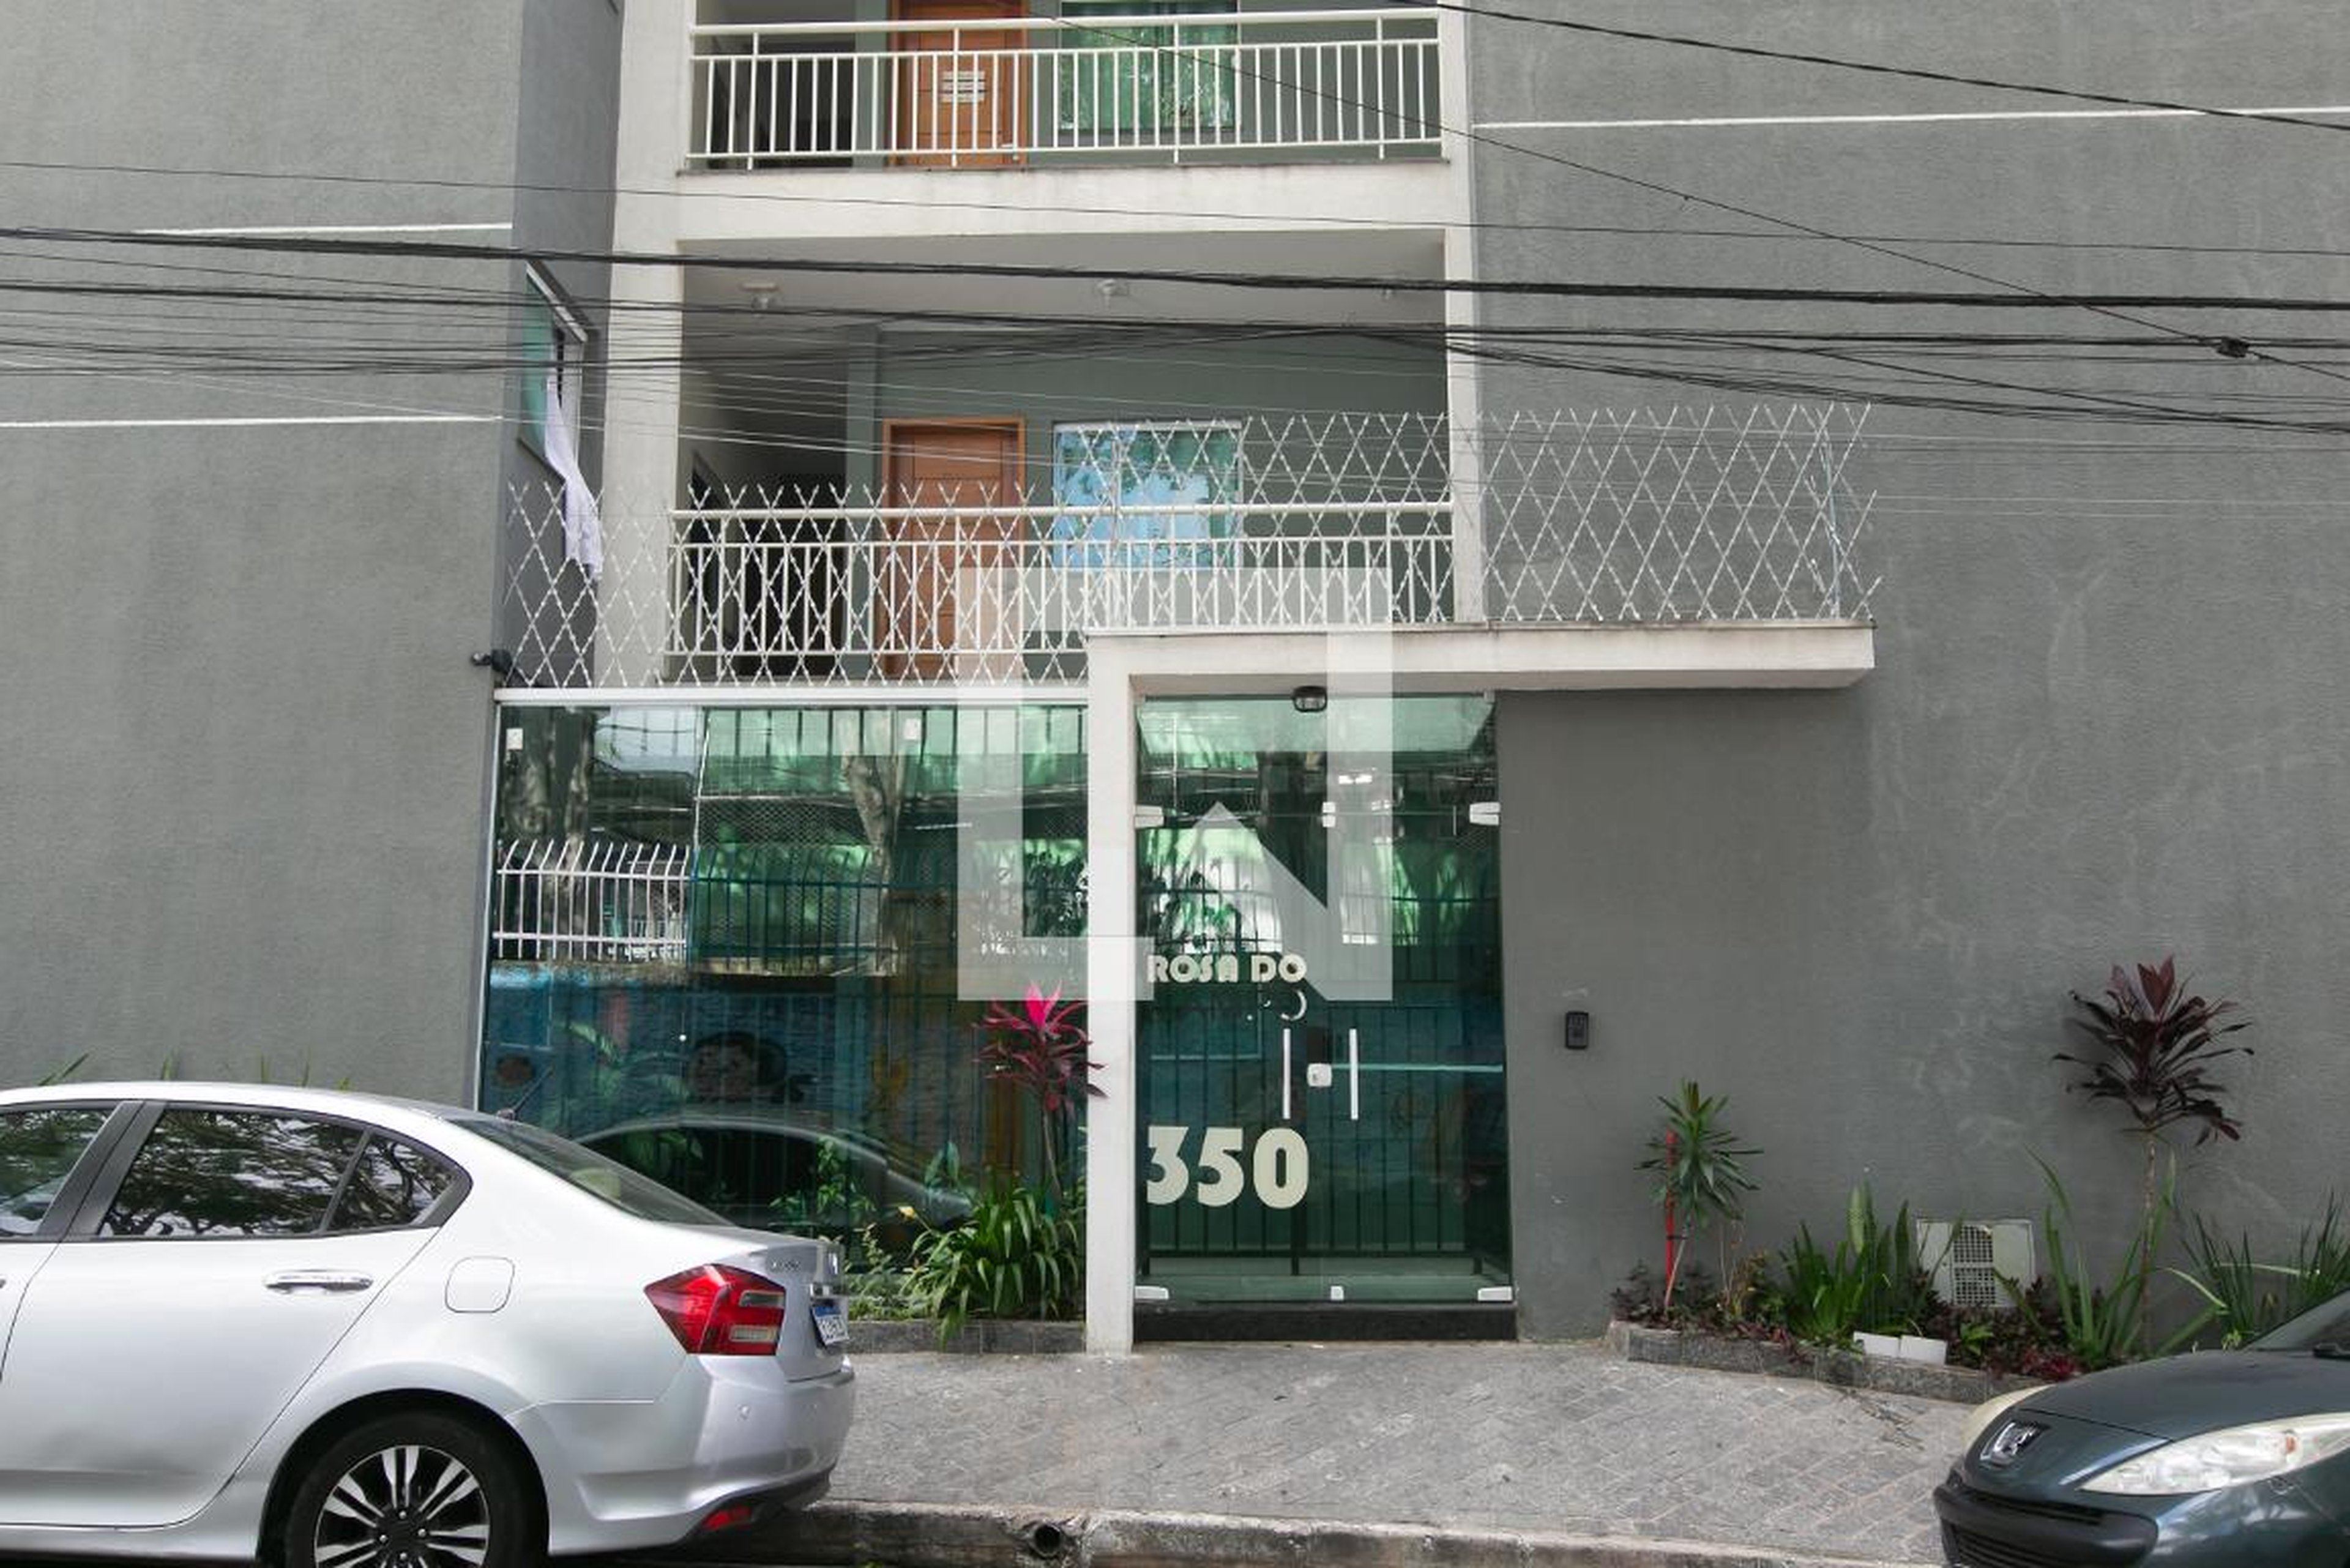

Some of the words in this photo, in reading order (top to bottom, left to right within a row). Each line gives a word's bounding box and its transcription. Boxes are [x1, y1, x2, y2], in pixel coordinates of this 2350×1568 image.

[1146, 954, 1239, 982] ROSA
[1251, 953, 1307, 983] DO
[1146, 1126, 1309, 1209] 350
